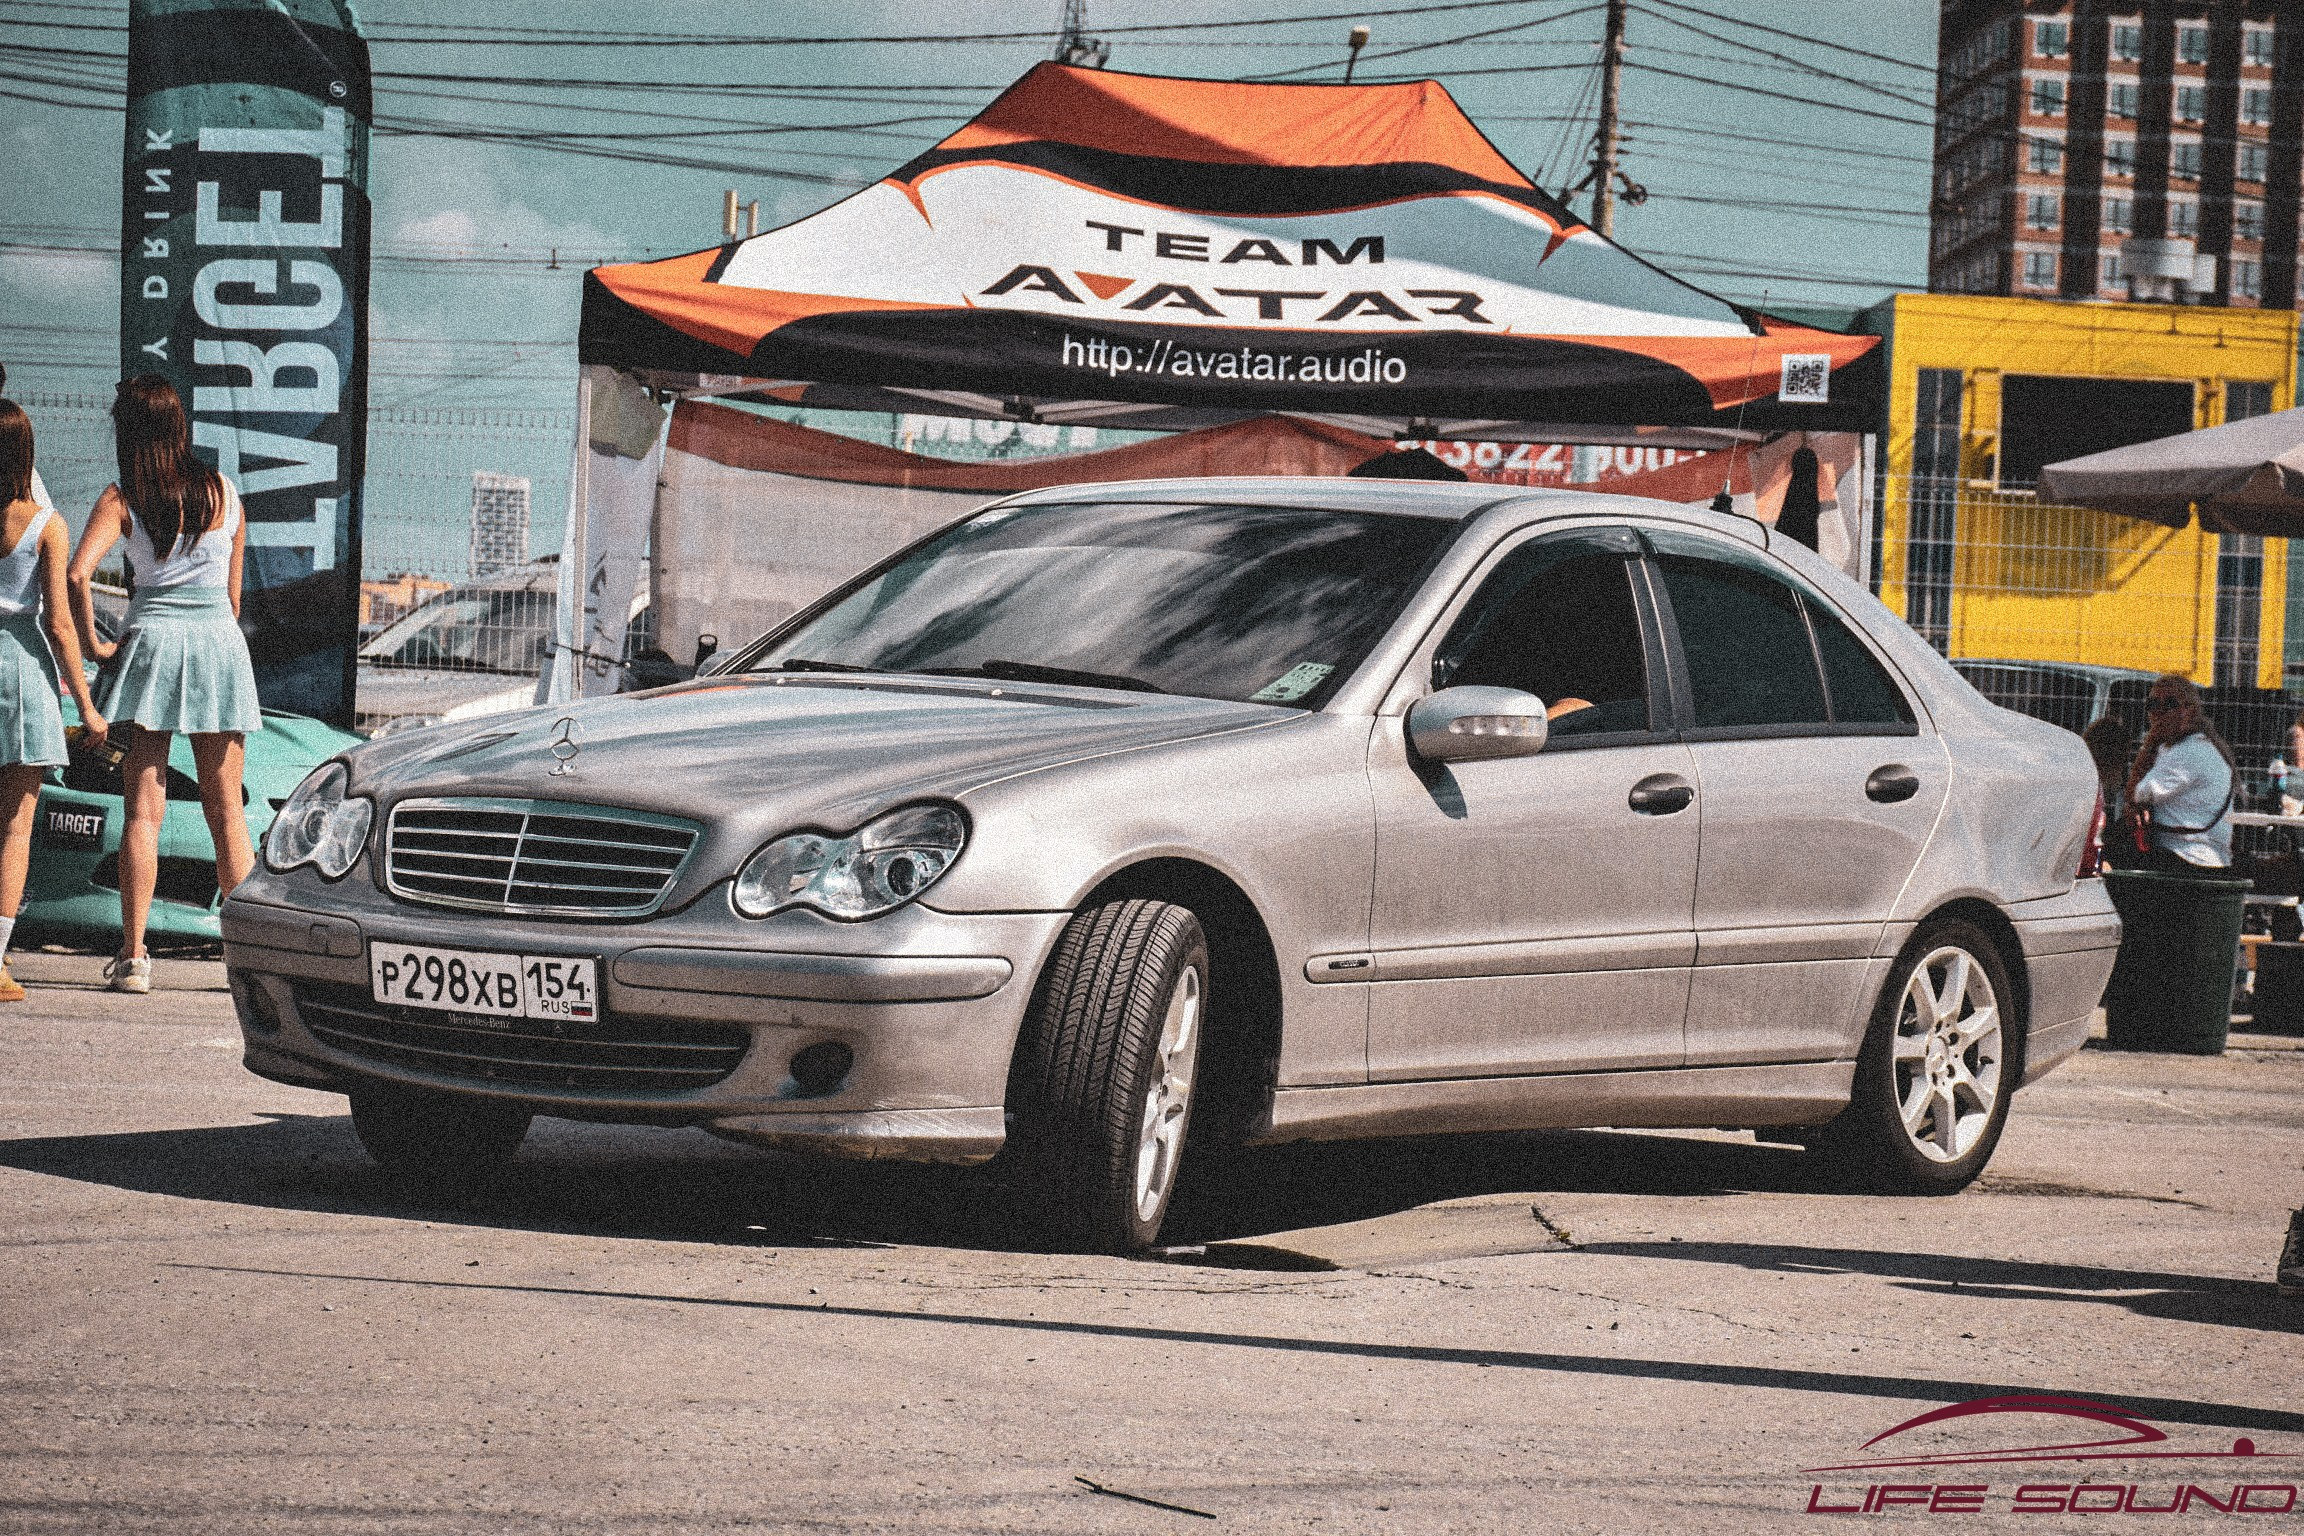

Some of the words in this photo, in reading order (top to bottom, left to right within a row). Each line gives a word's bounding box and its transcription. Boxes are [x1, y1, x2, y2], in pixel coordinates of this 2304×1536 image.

[1085, 220, 1385, 266] TEAM
[979, 264, 1494, 325] AVATAR
[1061, 333, 1407, 384] http://avatar.audio
[49, 812, 103, 835] TARGET
[526, 962, 586, 1001] 154
[541, 1000, 570, 1014] RUS
